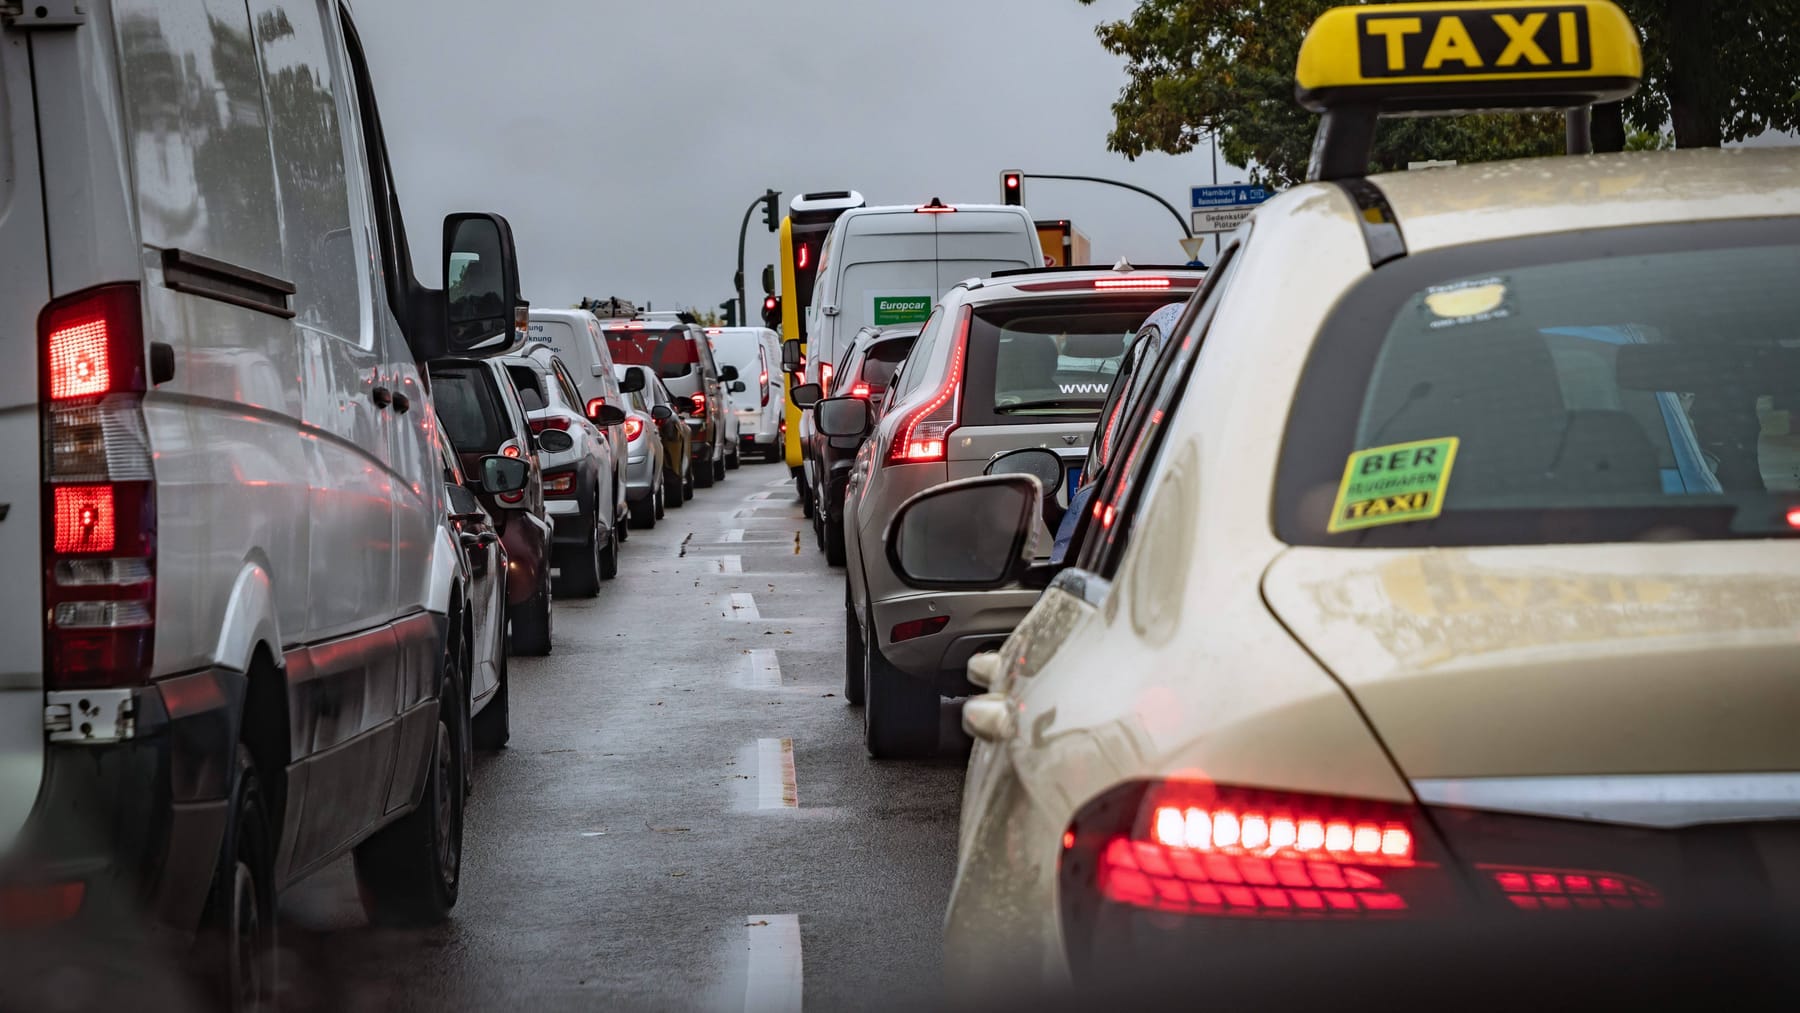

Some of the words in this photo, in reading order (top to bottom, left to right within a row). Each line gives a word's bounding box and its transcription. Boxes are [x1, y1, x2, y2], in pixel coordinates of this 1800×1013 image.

[1365, 11, 1580, 71] TAXI
[1202, 188, 1236, 198] Hamburg
[880, 301, 926, 312] Europcar
[1360, 447, 1438, 476] BER
[1350, 492, 1427, 518] TAXI
